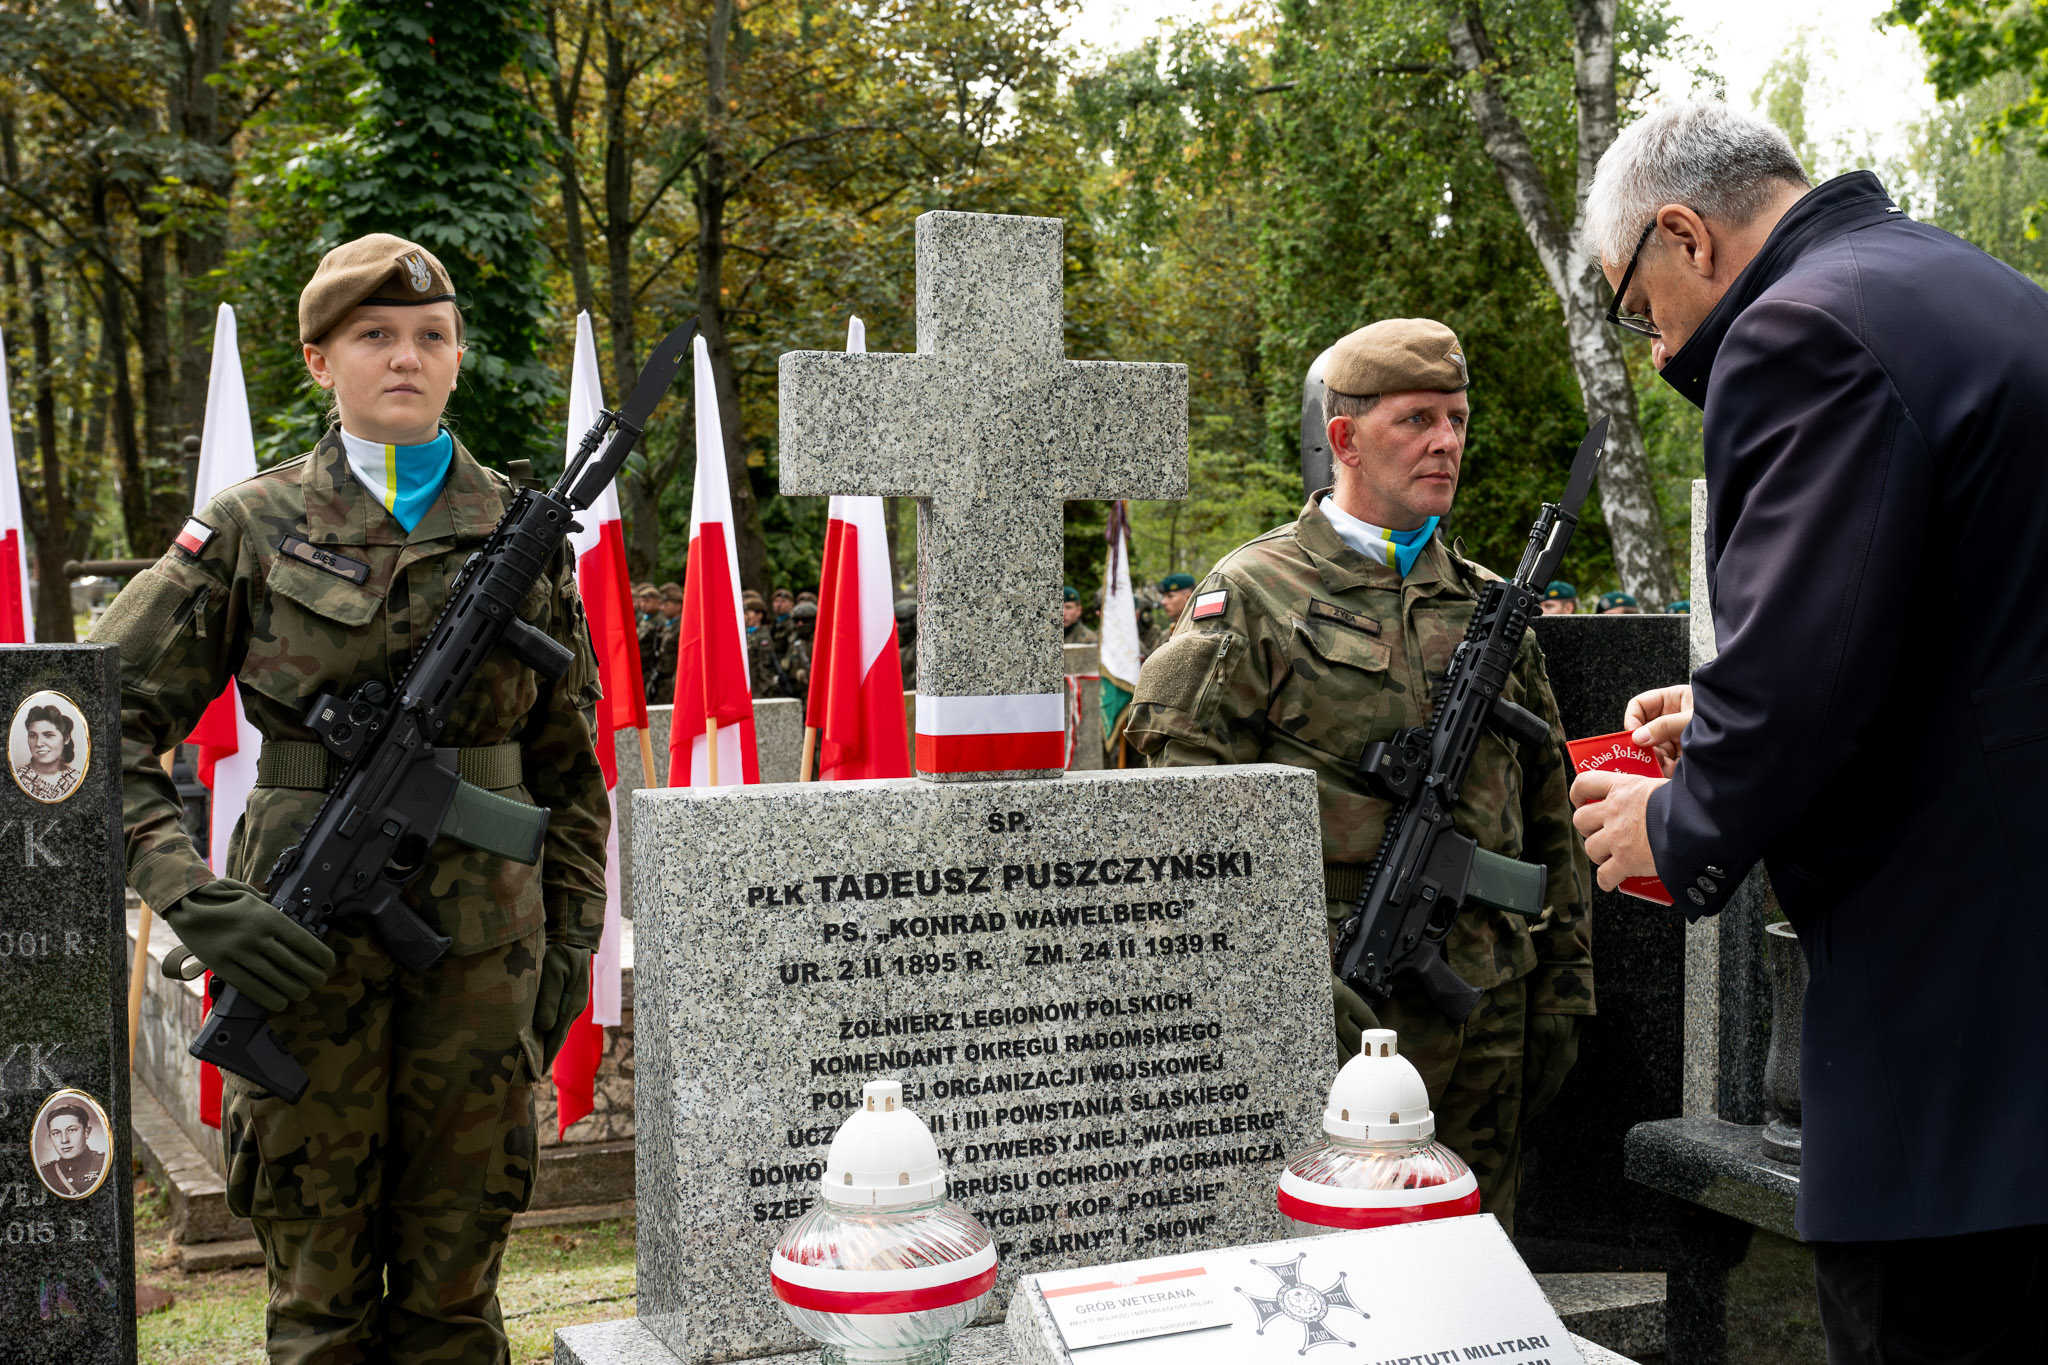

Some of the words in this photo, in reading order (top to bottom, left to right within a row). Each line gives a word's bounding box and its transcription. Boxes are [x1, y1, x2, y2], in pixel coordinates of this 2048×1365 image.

[312, 551, 336, 566] BIES
[1578, 751, 1614, 771] Tobie
[1611, 744, 1652, 764] Polsko
[747, 884, 806, 908] PŁK
[813, 867, 991, 903] TADEUSZ
[1003, 849, 1251, 891] PUSZCZYŃSKI
[823, 922, 868, 944] PS.
[877, 912, 1007, 945] „KONRAD
[1014, 899, 1194, 931] WAWELBERG”
[780, 962, 829, 986] UR.
[838, 960, 855, 981] 2
[864, 957, 882, 979] II
[892, 952, 957, 976] 1895
[966, 950, 992, 971] R.
[1024, 944, 1071, 967] ZM.
[1080, 941, 1110, 963] 24
[1119, 938, 1136, 959] II
[1144, 933, 1203, 957] 1939
[1212, 932, 1236, 951] R.
[961, 998, 1079, 1029] LEGIONÓW
[1086, 992, 1193, 1019] POLSKICH
[810, 1045, 957, 1077] KOMENDANT
[965, 1036, 1058, 1063] OKRĘGU
[1065, 1022, 1222, 1053] RADOMSKIEGO
[933, 1068, 1084, 1099] ORGANIZACJI
[1090, 1052, 1224, 1084] WOJSKOWEJ
[952, 1112, 959, 1131] i
[966, 1110, 988, 1129] III
[996, 1096, 1124, 1126] POWSTANIA
[965, 1127, 1127, 1163] DYWERSYJNEJ
[1133, 1110, 1285, 1149] „WAWELBERG”
[1036, 1159, 1144, 1189] OCHRONY
[1150, 1143, 1286, 1175] POGRANICZA
[1067, 1196, 1111, 1219] KOP
[1118, 1181, 1225, 1216] „POLESIE”
[0, 1219, 56, 1244] 015
[1075, 1300, 1117, 1314] GRÓB
[1118, 1288, 1196, 1307] WETERANA
[1259, 1303, 1277, 1313] VIR
[1327, 1292, 1347, 1304] TUTI
[1310, 1330, 1331, 1341] TARI
[1462, 1335, 1551, 1361] MILITARI
